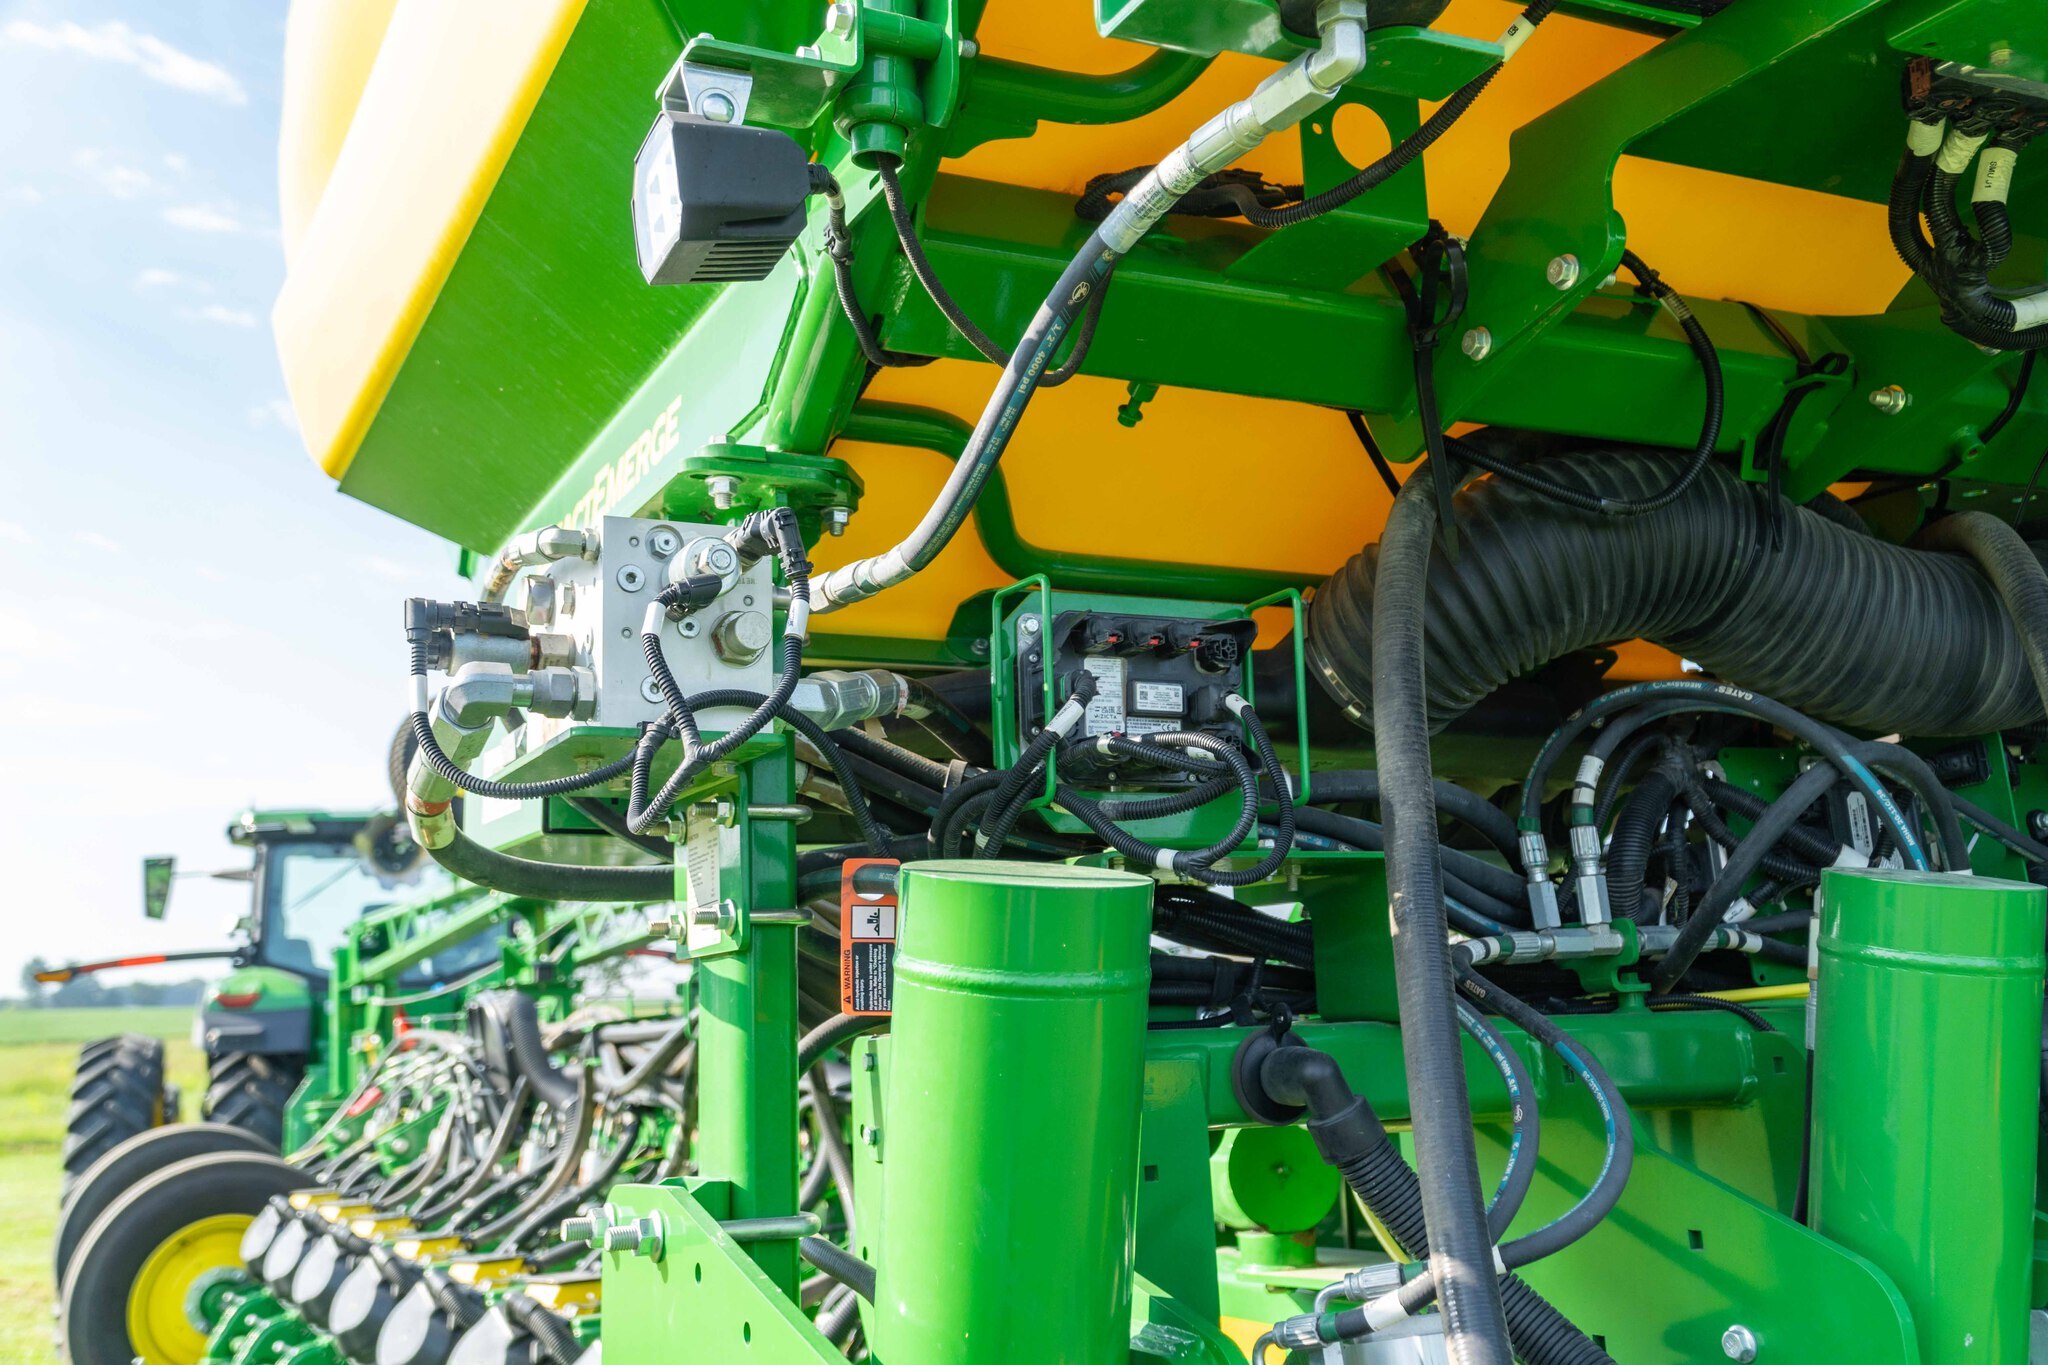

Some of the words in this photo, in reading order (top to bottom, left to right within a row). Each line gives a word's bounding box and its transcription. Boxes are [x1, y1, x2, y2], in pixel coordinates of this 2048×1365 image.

[1029, 350, 1046, 376] 4000
[1018, 375, 1031, 394] psi
[1901, 825, 1915, 846] MSHA
[1465, 980, 1486, 998] GATES
